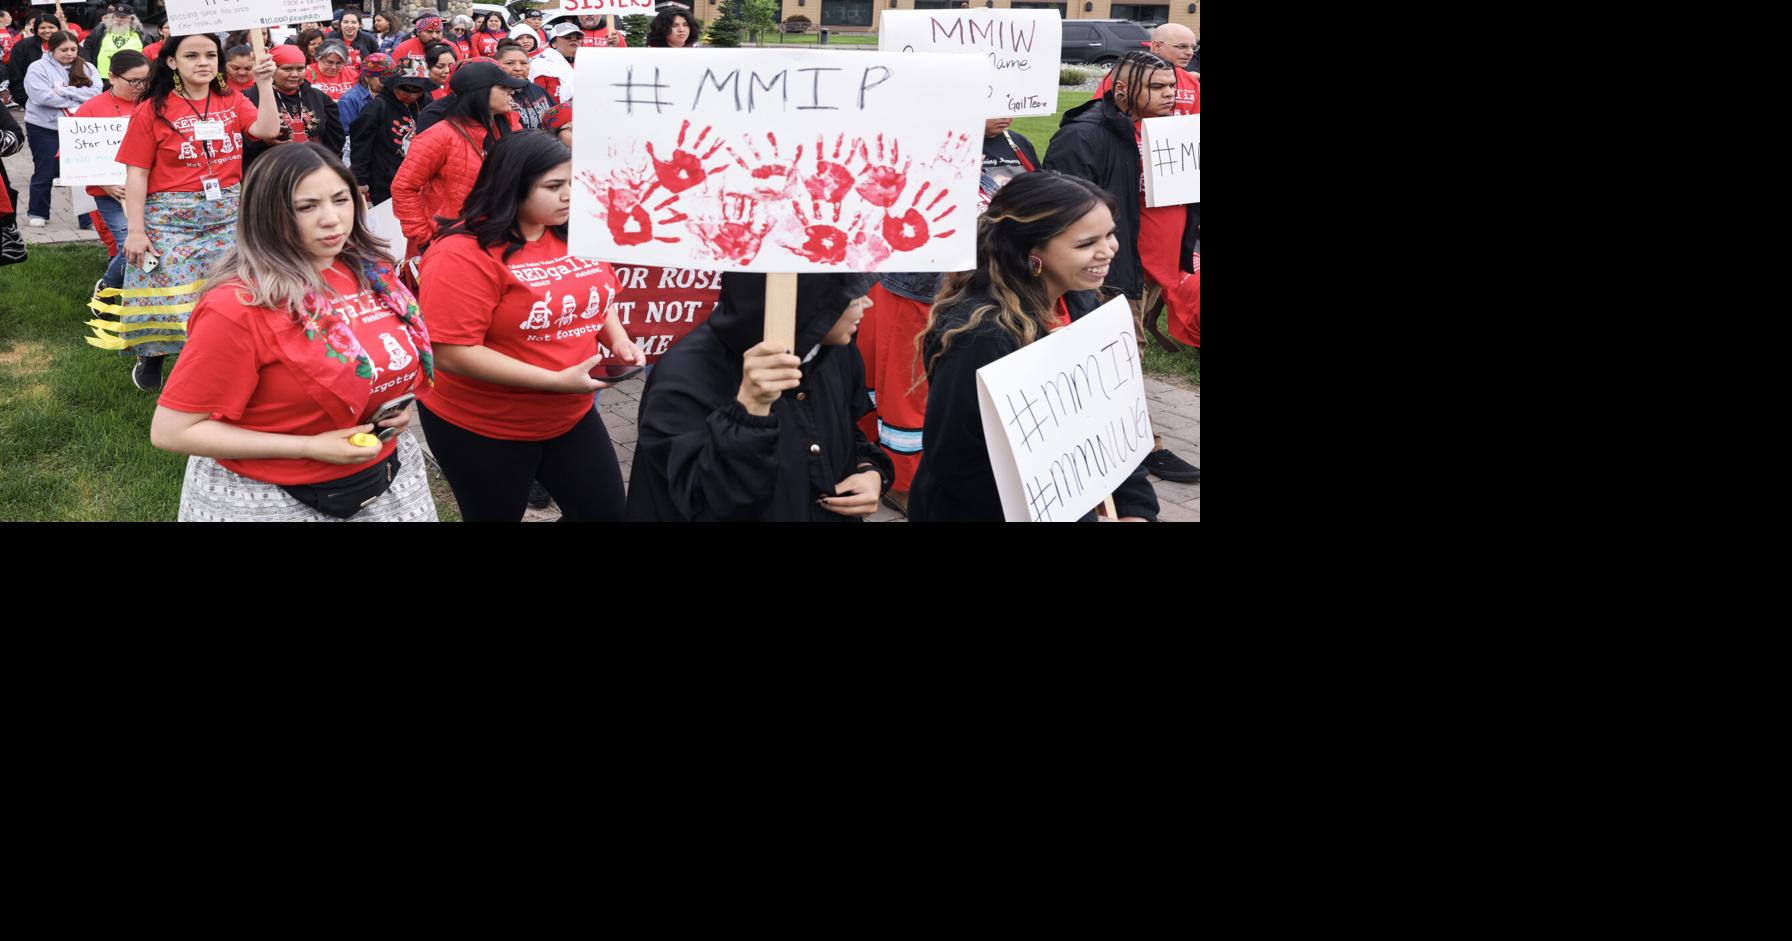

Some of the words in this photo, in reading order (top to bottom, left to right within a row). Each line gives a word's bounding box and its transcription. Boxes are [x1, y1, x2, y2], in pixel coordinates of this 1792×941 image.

[930, 17, 1036, 52] MMIW
[609, 64, 893, 114] #MMIP
[70, 120, 122, 134] Justice
[75, 138, 101, 149] Star
[1152, 138, 1200, 177] #M
[510, 258, 600, 282] REDgalia
[645, 301, 702, 323] NOT
